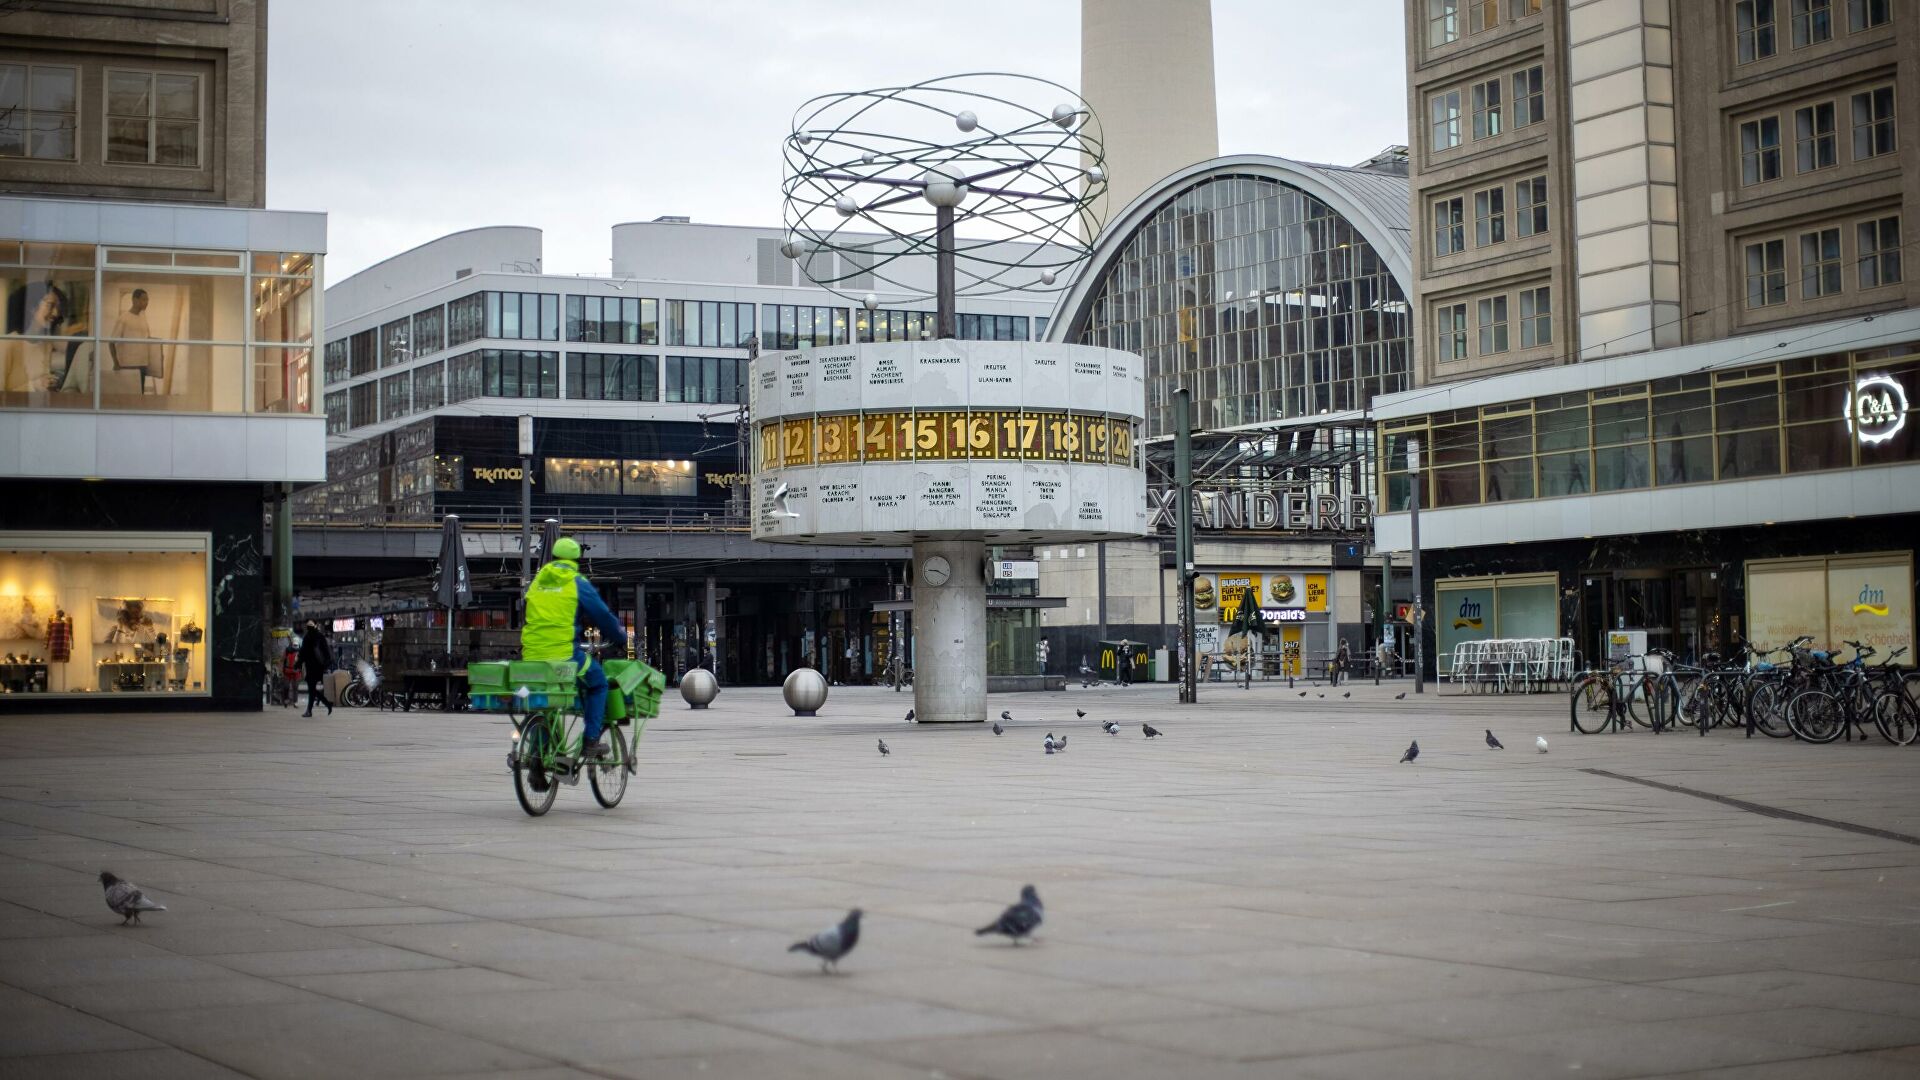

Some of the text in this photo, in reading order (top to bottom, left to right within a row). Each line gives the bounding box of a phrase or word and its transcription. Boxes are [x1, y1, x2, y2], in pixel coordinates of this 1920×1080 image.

[1857, 390, 1898, 424] C&A
[783, 426, 804, 457] 12
[813, 423, 841, 454] 13
[852, 420, 886, 451] 14
[900, 419, 938, 450] 15
[952, 418, 990, 449] 16
[1003, 419, 1039, 449] 17
[1050, 421, 1080, 452] 18
[1087, 423, 1107, 453] 19
[1114, 426, 1130, 458] 20
[1221, 577, 1251, 587] BURGER
[1858, 584, 1884, 604] dm
[1459, 597, 1481, 618] dm
